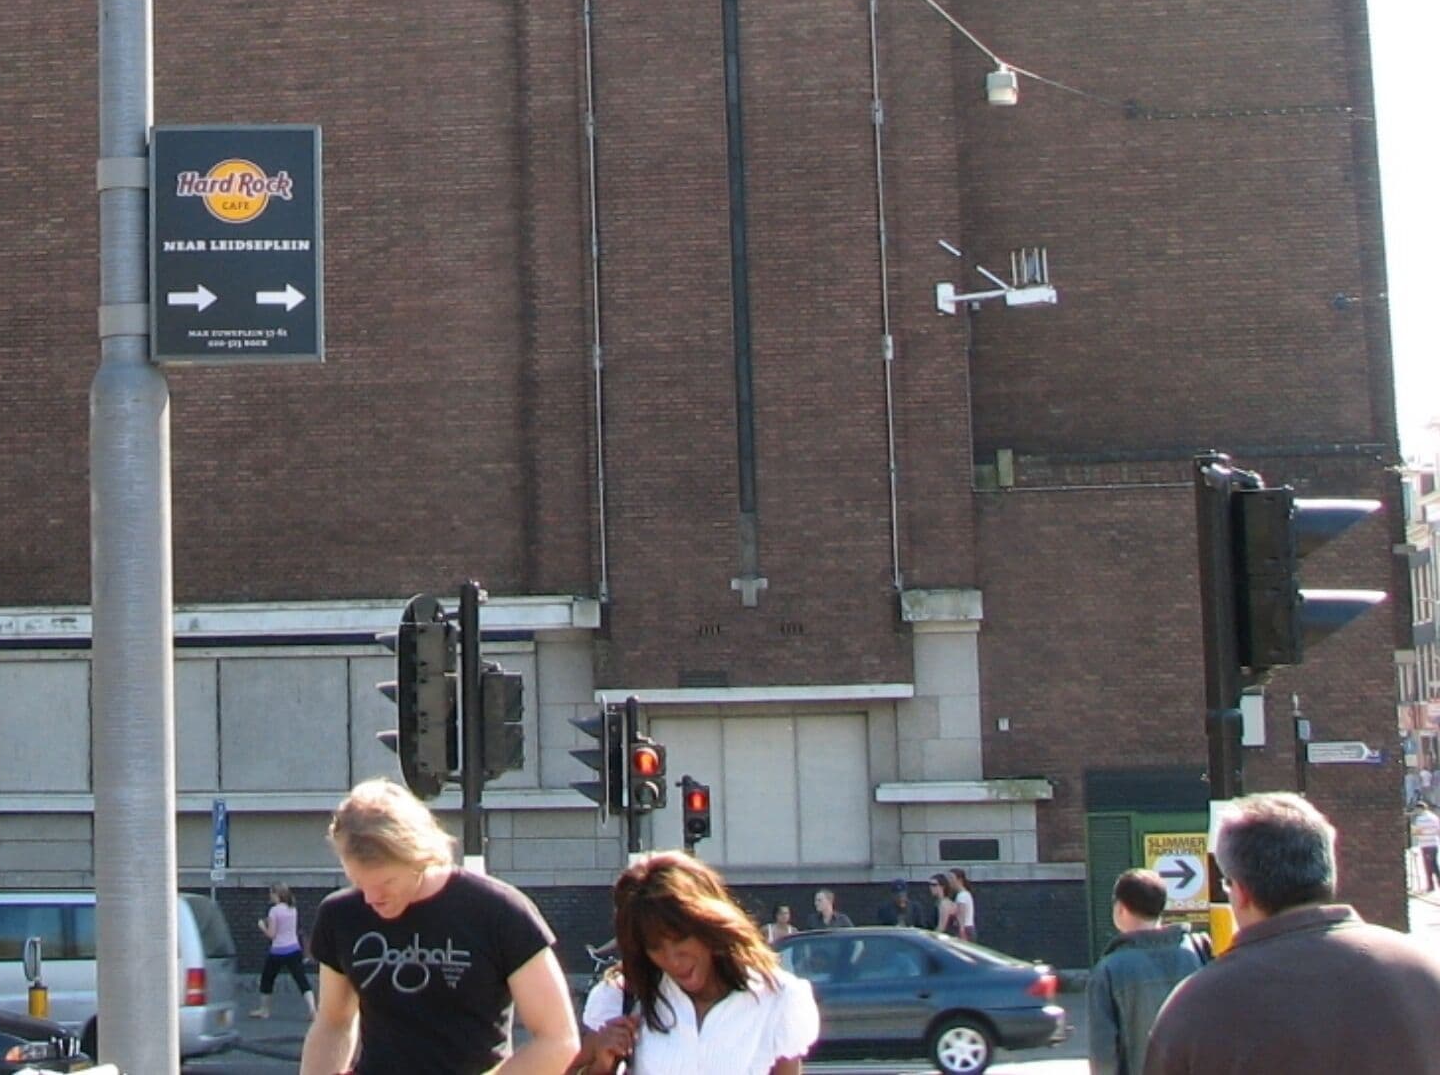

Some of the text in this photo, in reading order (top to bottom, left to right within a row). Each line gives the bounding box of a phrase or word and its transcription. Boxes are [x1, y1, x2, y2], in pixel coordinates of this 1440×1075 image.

[177, 171, 292, 200] Hard Rock
[163, 240, 310, 251] NEAR LEIDSEPLEIN
